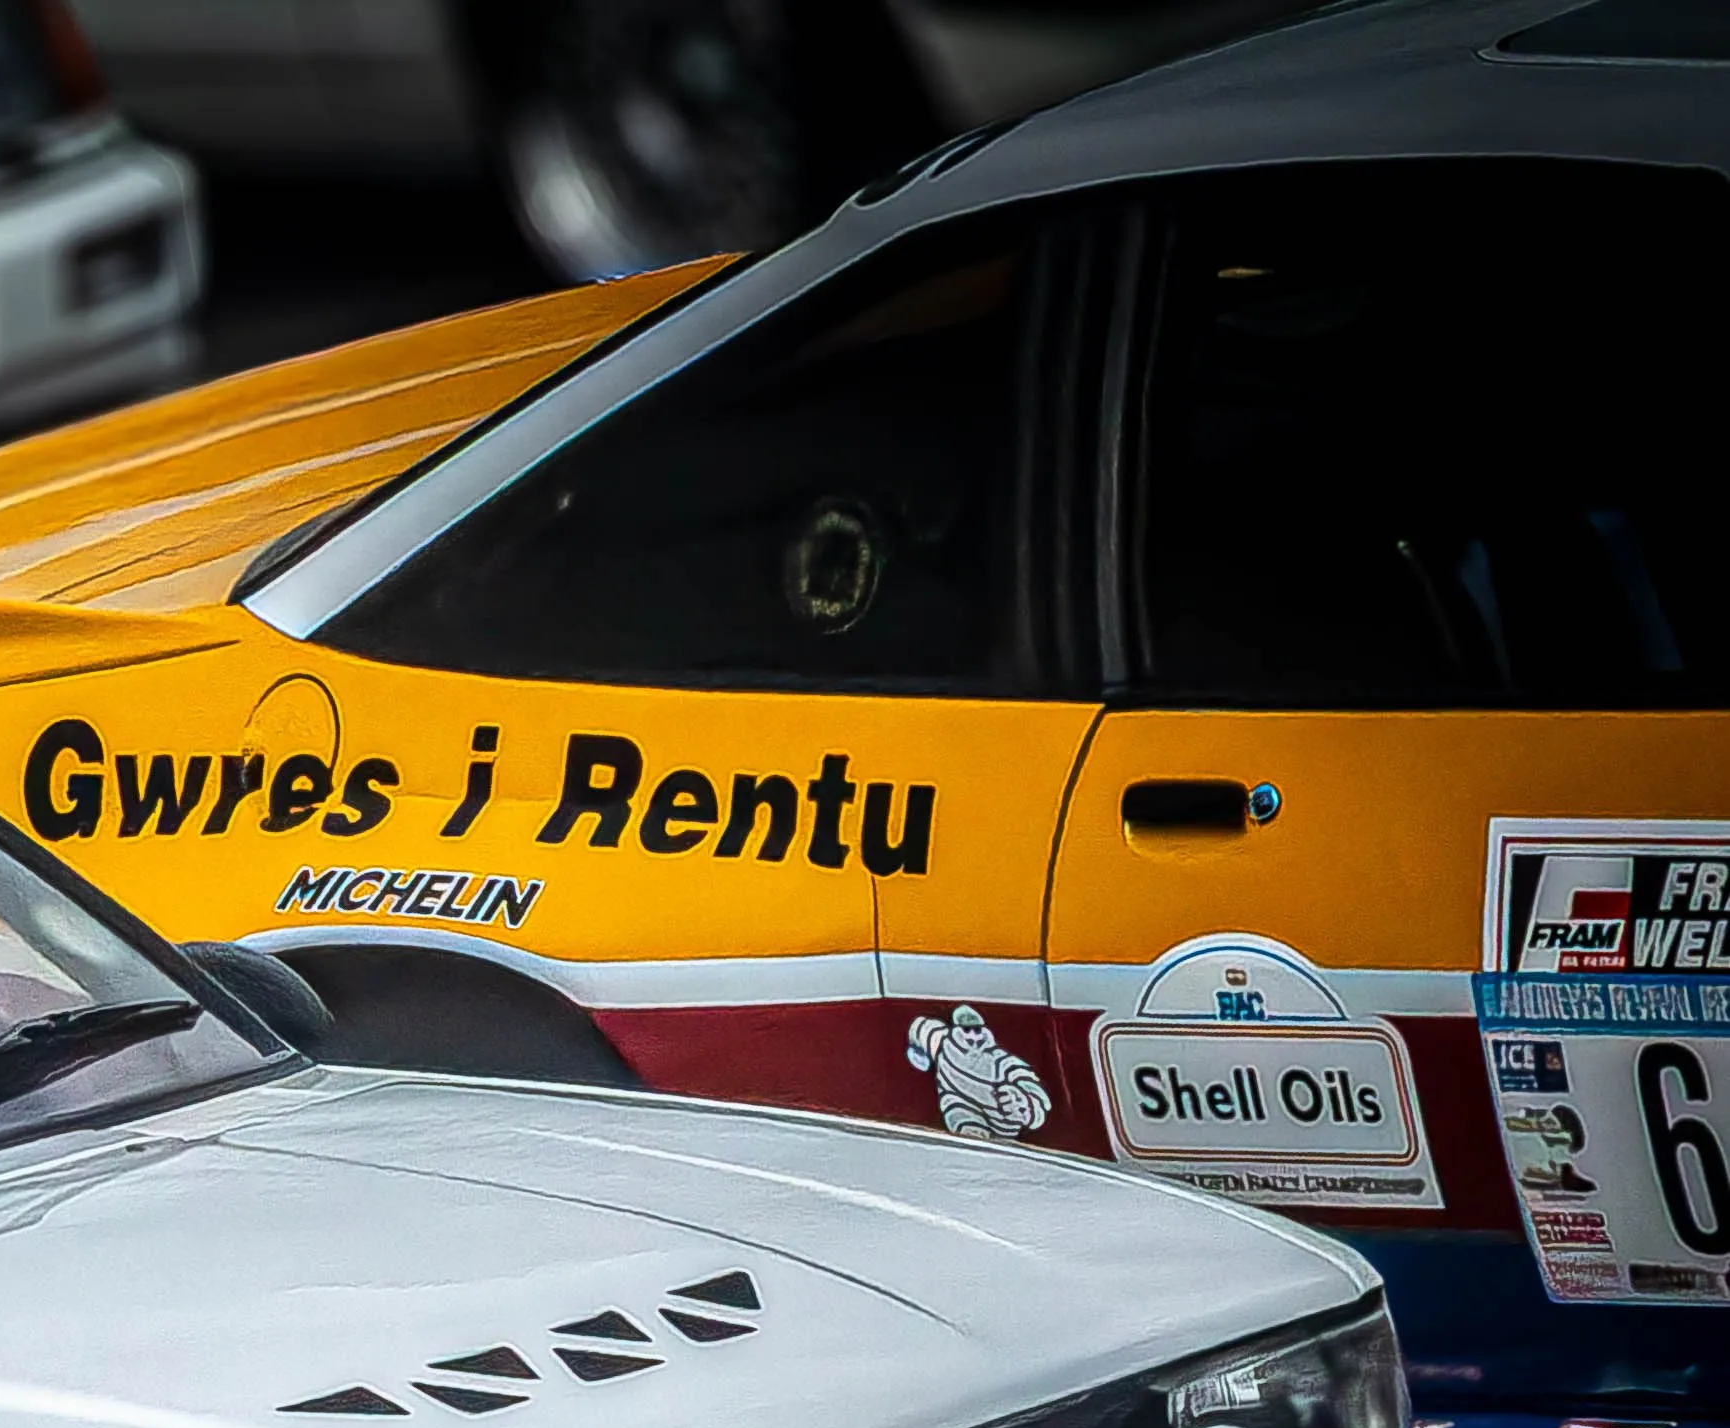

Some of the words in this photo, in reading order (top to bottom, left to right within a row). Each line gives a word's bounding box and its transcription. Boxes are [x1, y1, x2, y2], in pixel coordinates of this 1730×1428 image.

[23, 717, 398, 841] Gwres
[442, 726, 500, 838] i
[537, 733, 936, 877] Rentu
[278, 868, 543, 928] MICHELIN
[1658, 862, 1730, 912] FR
[1527, 921, 1621, 949] FRAM
[1134, 1066, 1266, 1121] Shell
[1280, 1069, 1382, 1123] Oils
[1637, 1041, 1730, 1256] 6
